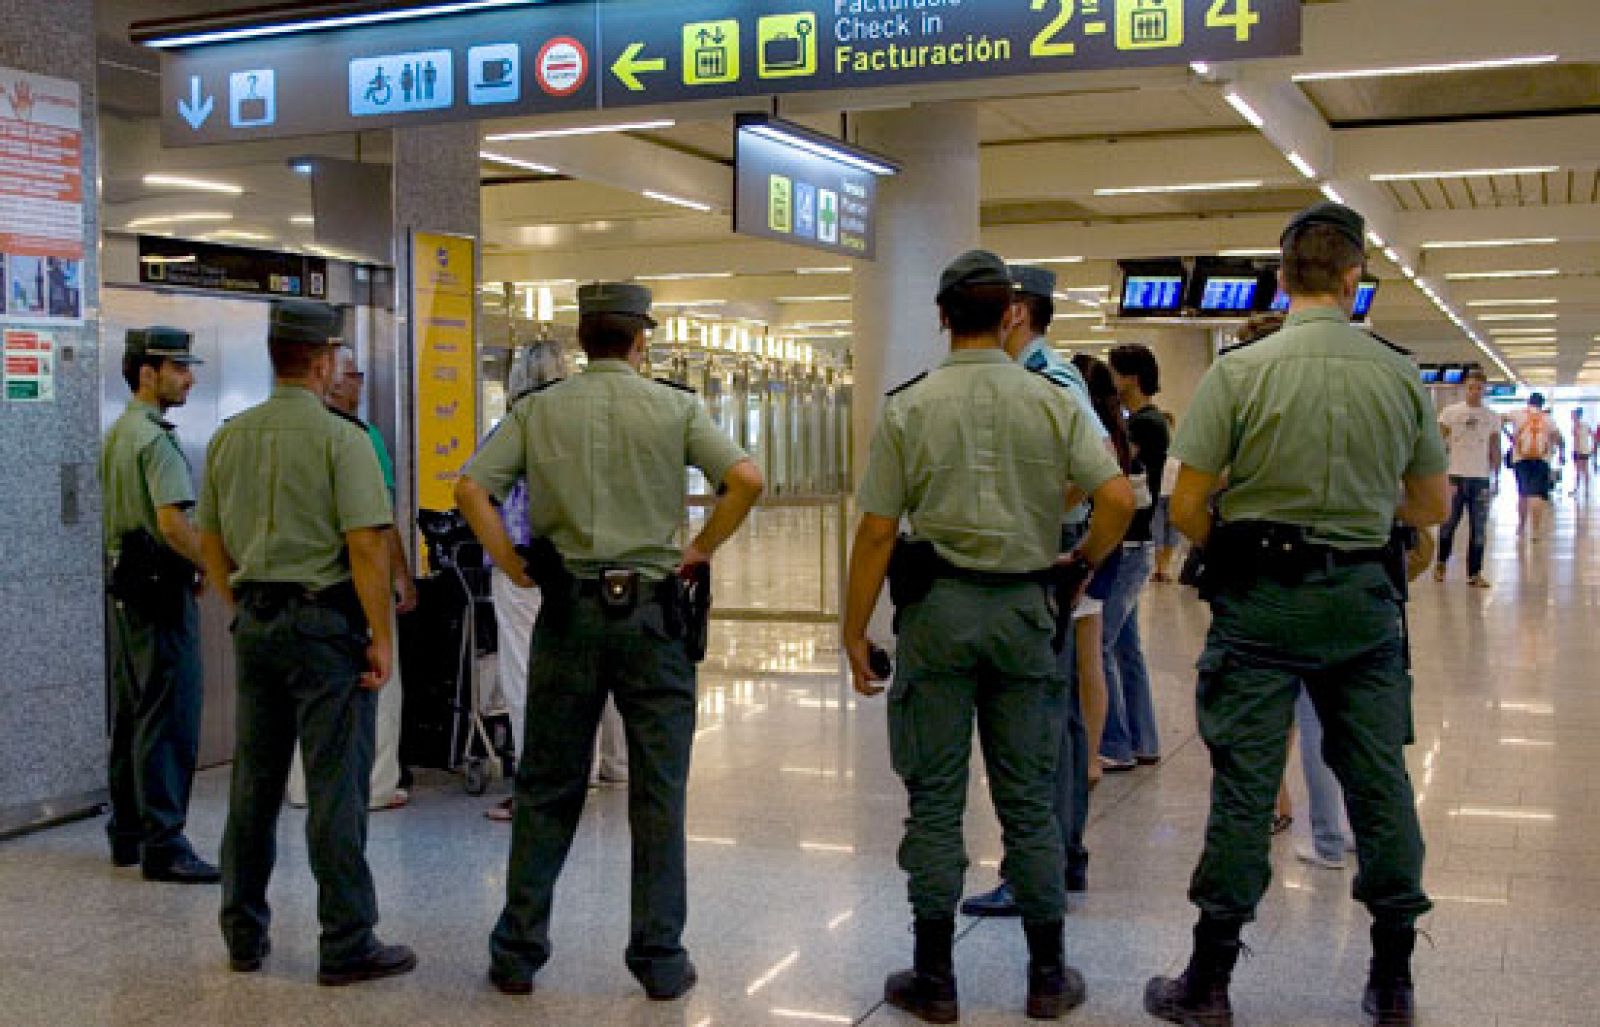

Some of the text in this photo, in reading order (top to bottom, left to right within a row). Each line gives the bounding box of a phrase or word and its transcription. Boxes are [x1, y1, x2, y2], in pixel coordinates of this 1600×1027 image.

[834, 11, 943, 41] Check in
[834, 34, 1011, 74] Facturación
